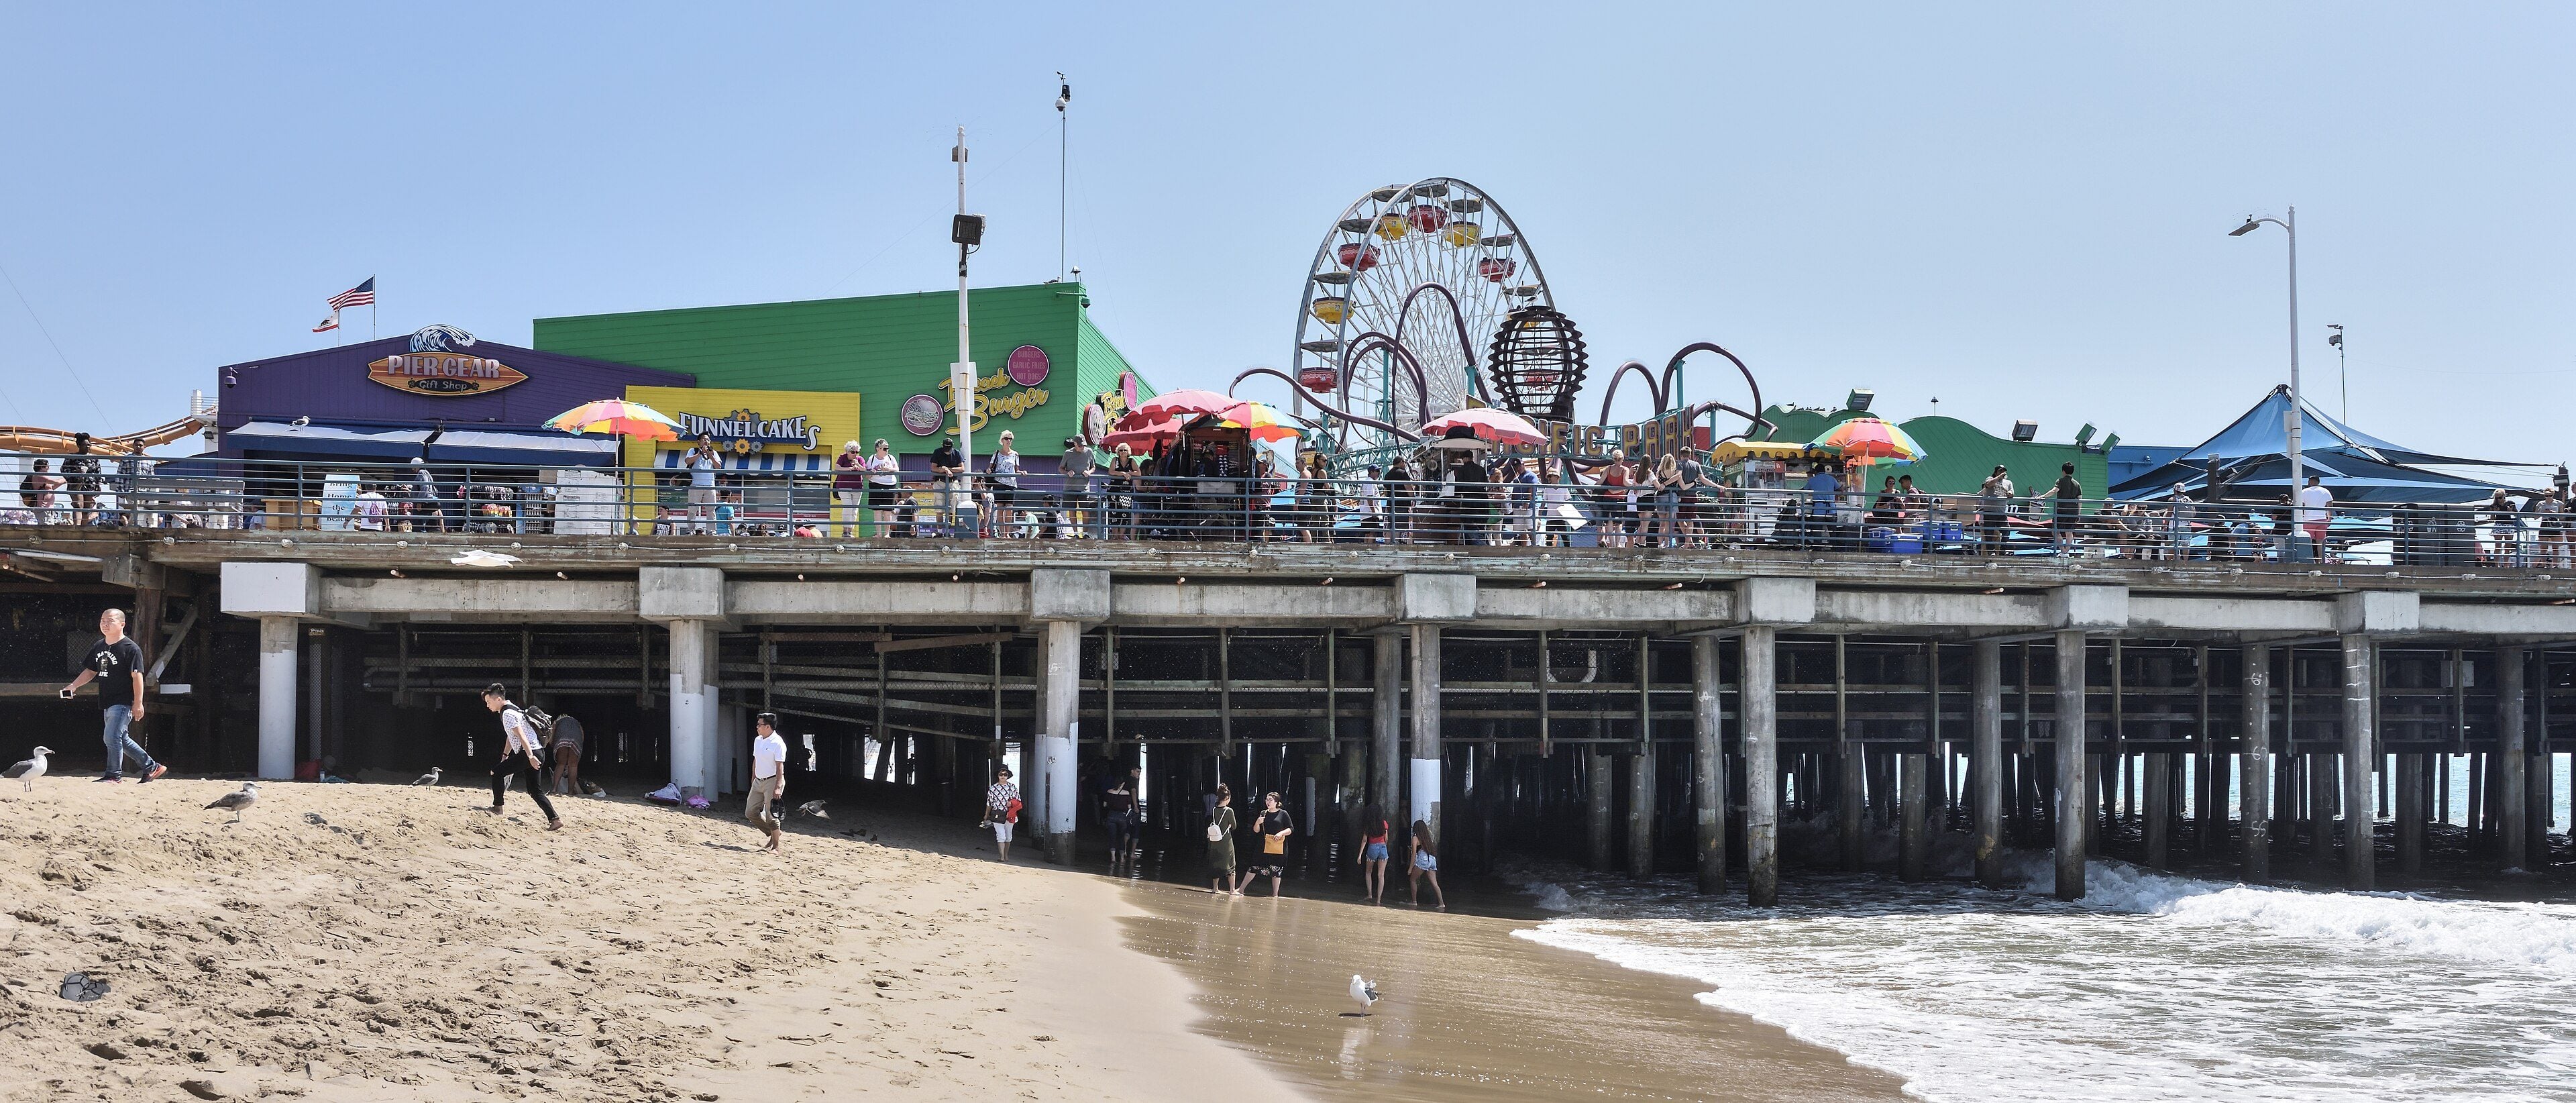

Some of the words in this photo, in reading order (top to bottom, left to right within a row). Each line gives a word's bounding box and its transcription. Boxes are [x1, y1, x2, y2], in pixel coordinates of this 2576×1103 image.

[388, 355, 438, 376] PIER
[442, 357, 500, 378] GEAR
[419, 380, 438, 389] Gift
[443, 380, 468, 392] Shop
[944, 387, 1049, 435] Burger
[679, 412, 755, 437] FUNNEL
[757, 415, 821, 451] CAKES
[1622, 404, 1695, 462] PARK
